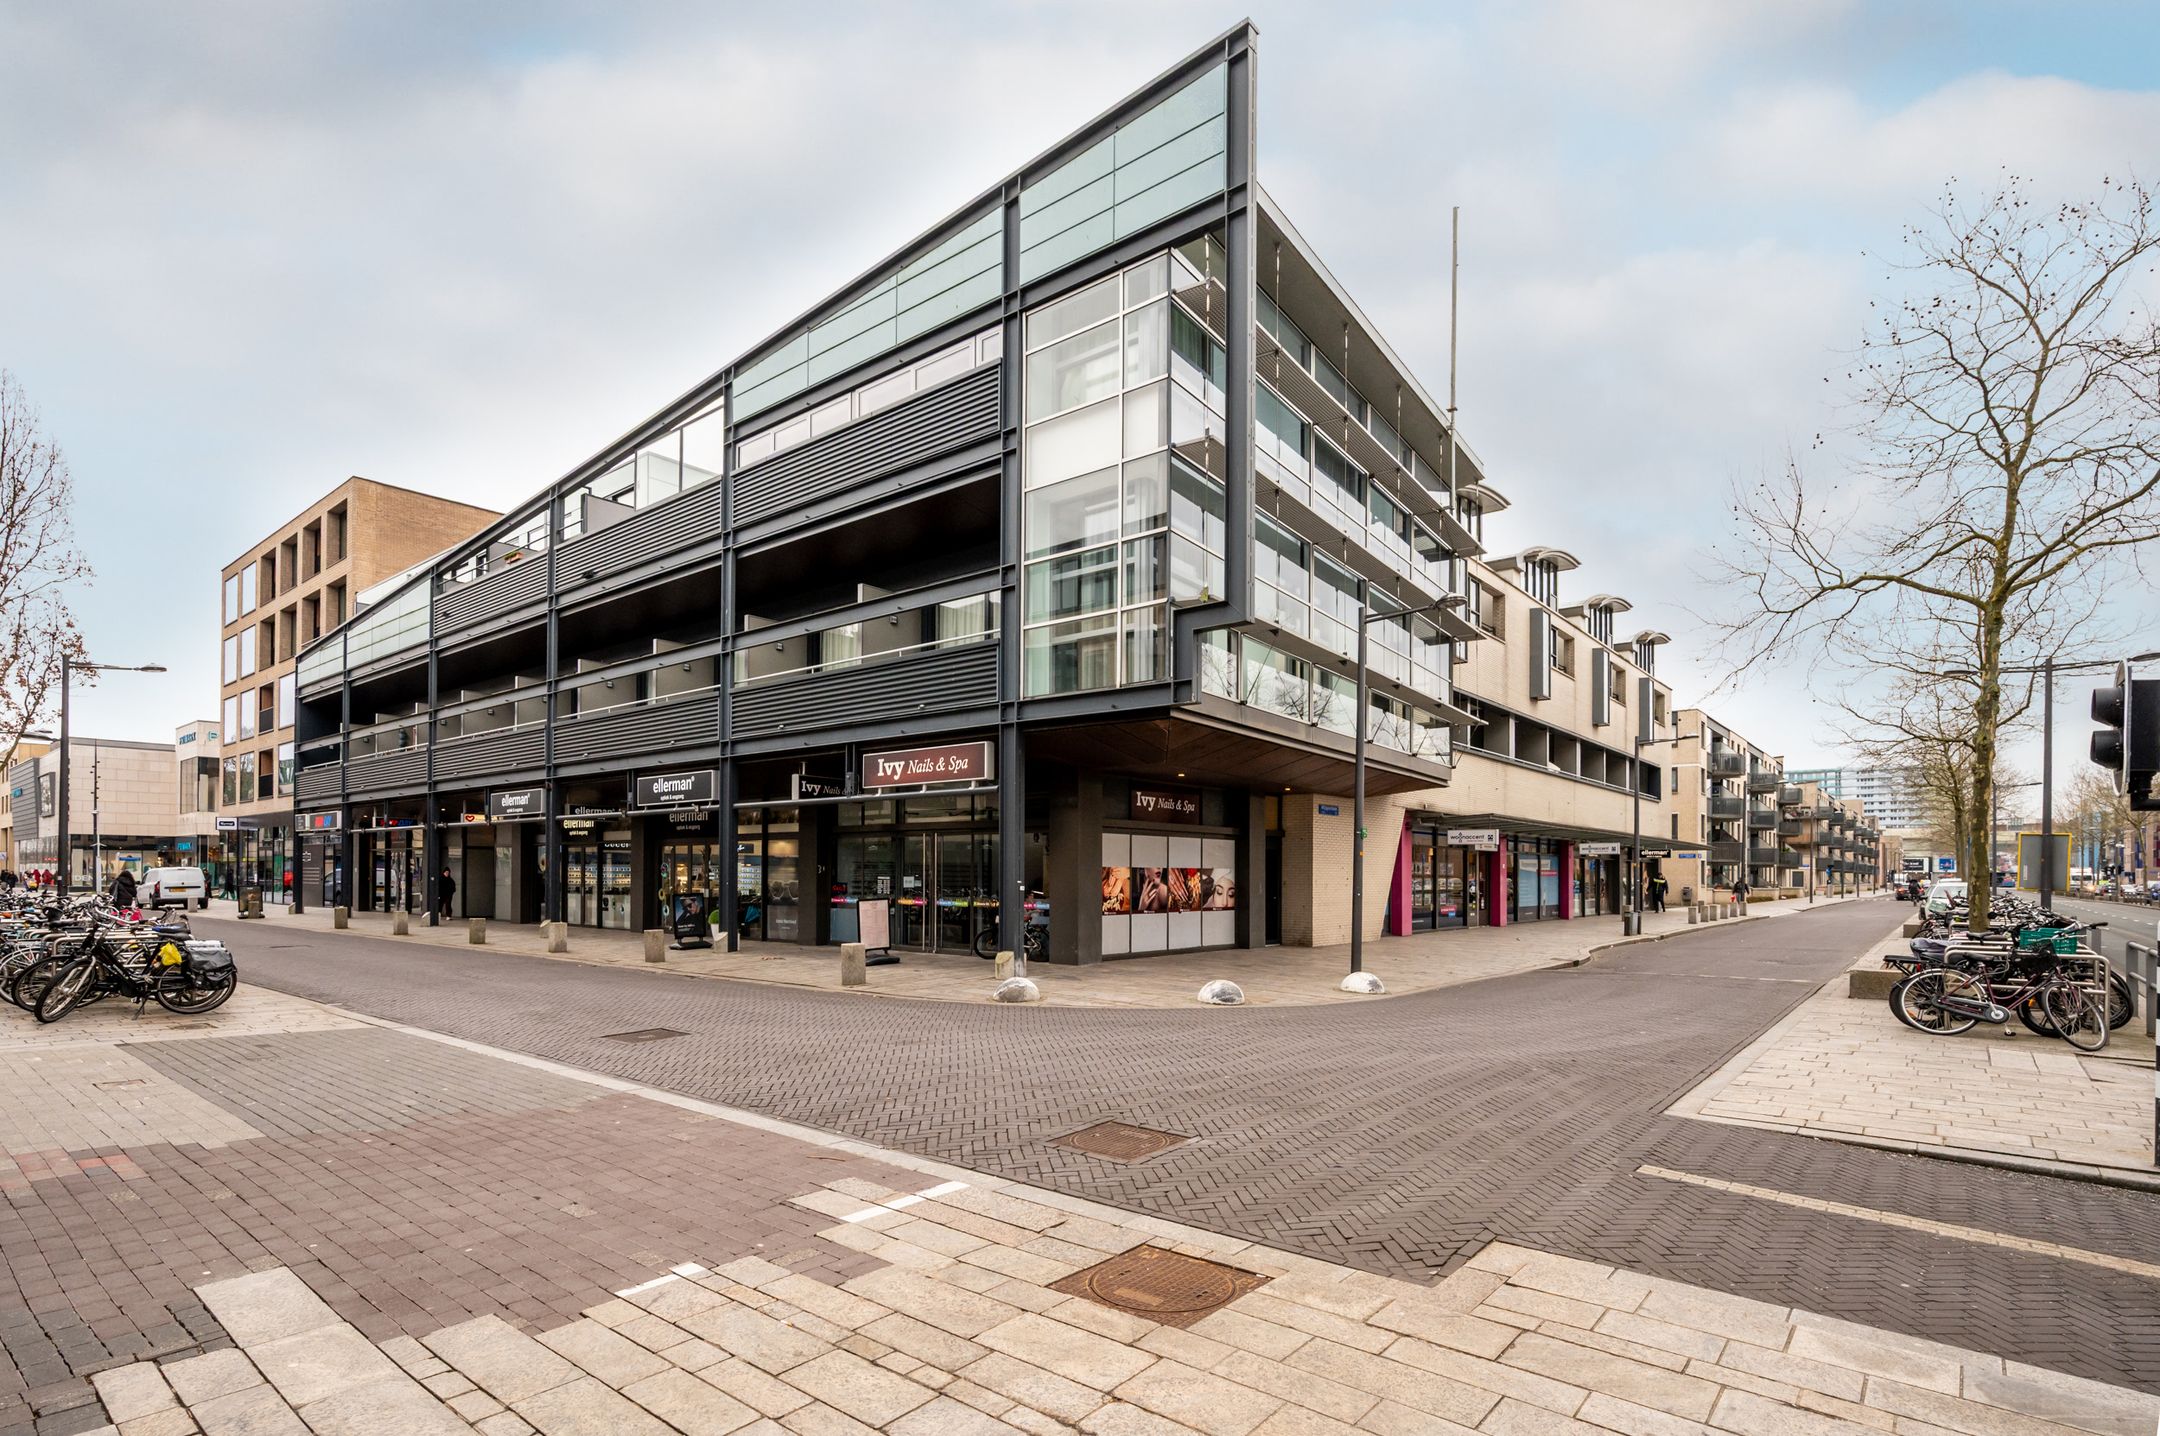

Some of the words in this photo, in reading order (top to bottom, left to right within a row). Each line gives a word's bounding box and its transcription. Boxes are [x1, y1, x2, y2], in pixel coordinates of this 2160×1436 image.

[877, 758, 905, 780] Ivy
[907, 758, 934, 774] Nails
[936, 757, 945, 771] &
[948, 755, 969, 774] Spa
[653, 778, 692, 793] ellerman
[801, 780, 821, 796] Ivy
[823, 785, 841, 795] Nails
[501, 794, 529, 807] ellerman
[1136, 791, 1156, 811] Ivy
[1157, 798, 1175, 810] Nails
[1175, 800, 1182, 810] &
[1183, 800, 1195, 813] Spa
[669, 810, 708, 822] ellerman
